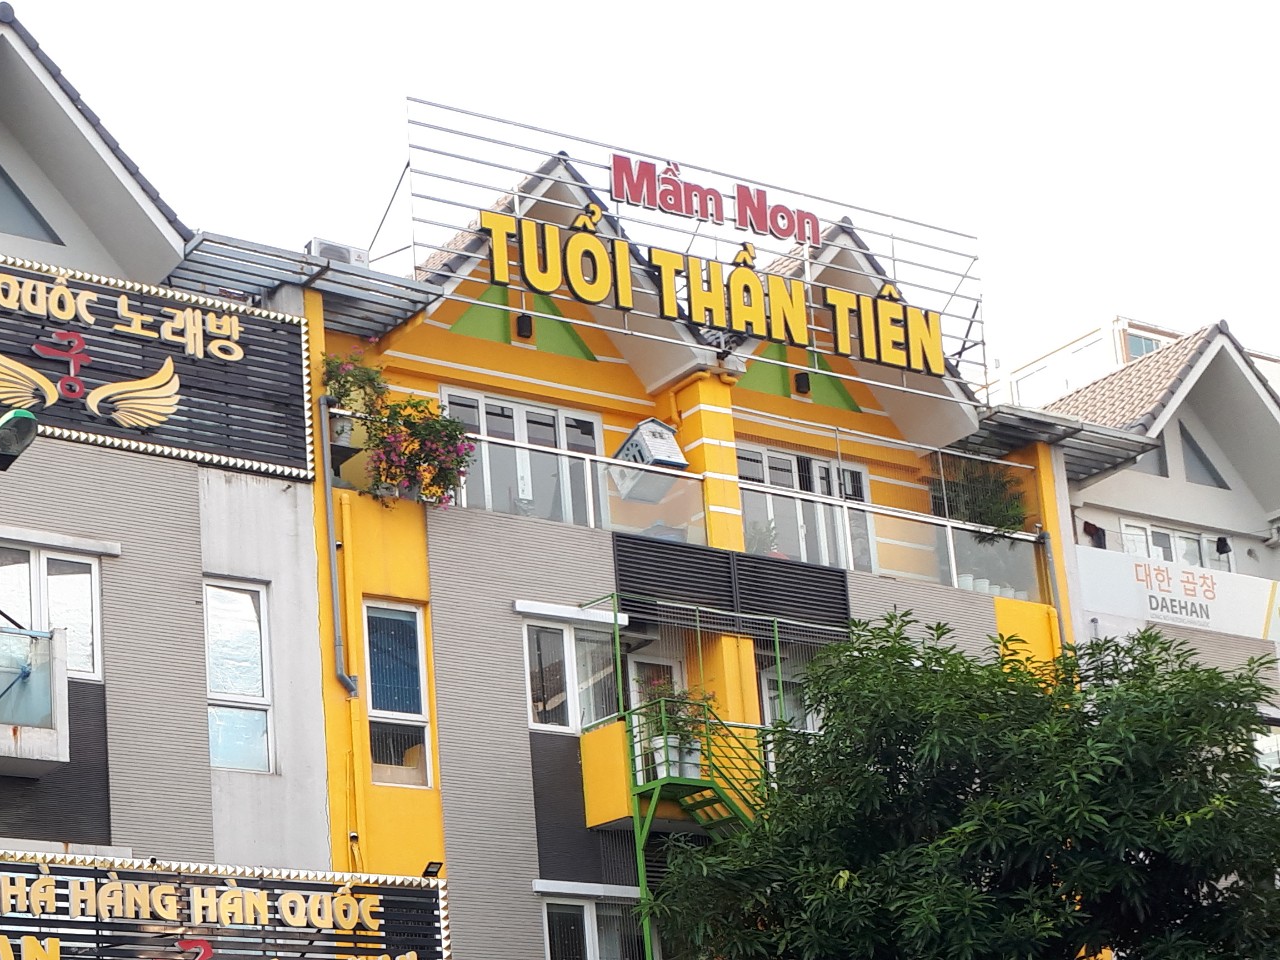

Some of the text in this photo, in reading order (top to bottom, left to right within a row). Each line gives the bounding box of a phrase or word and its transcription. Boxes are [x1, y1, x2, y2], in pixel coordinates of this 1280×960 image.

[610, 154, 821, 248] Mầm Non
[480, 202, 946, 377] TUỔI THẦN TIÊN
[113, 295, 245, 362] 노래방
[1134, 563, 1218, 601] 대한 곱창
[1148, 594, 1210, 619] DAEHAN
[69, 872, 178, 921] HÀNG
[190, 879, 269, 927] HÀN
[278, 880, 380, 931] QUỐC
